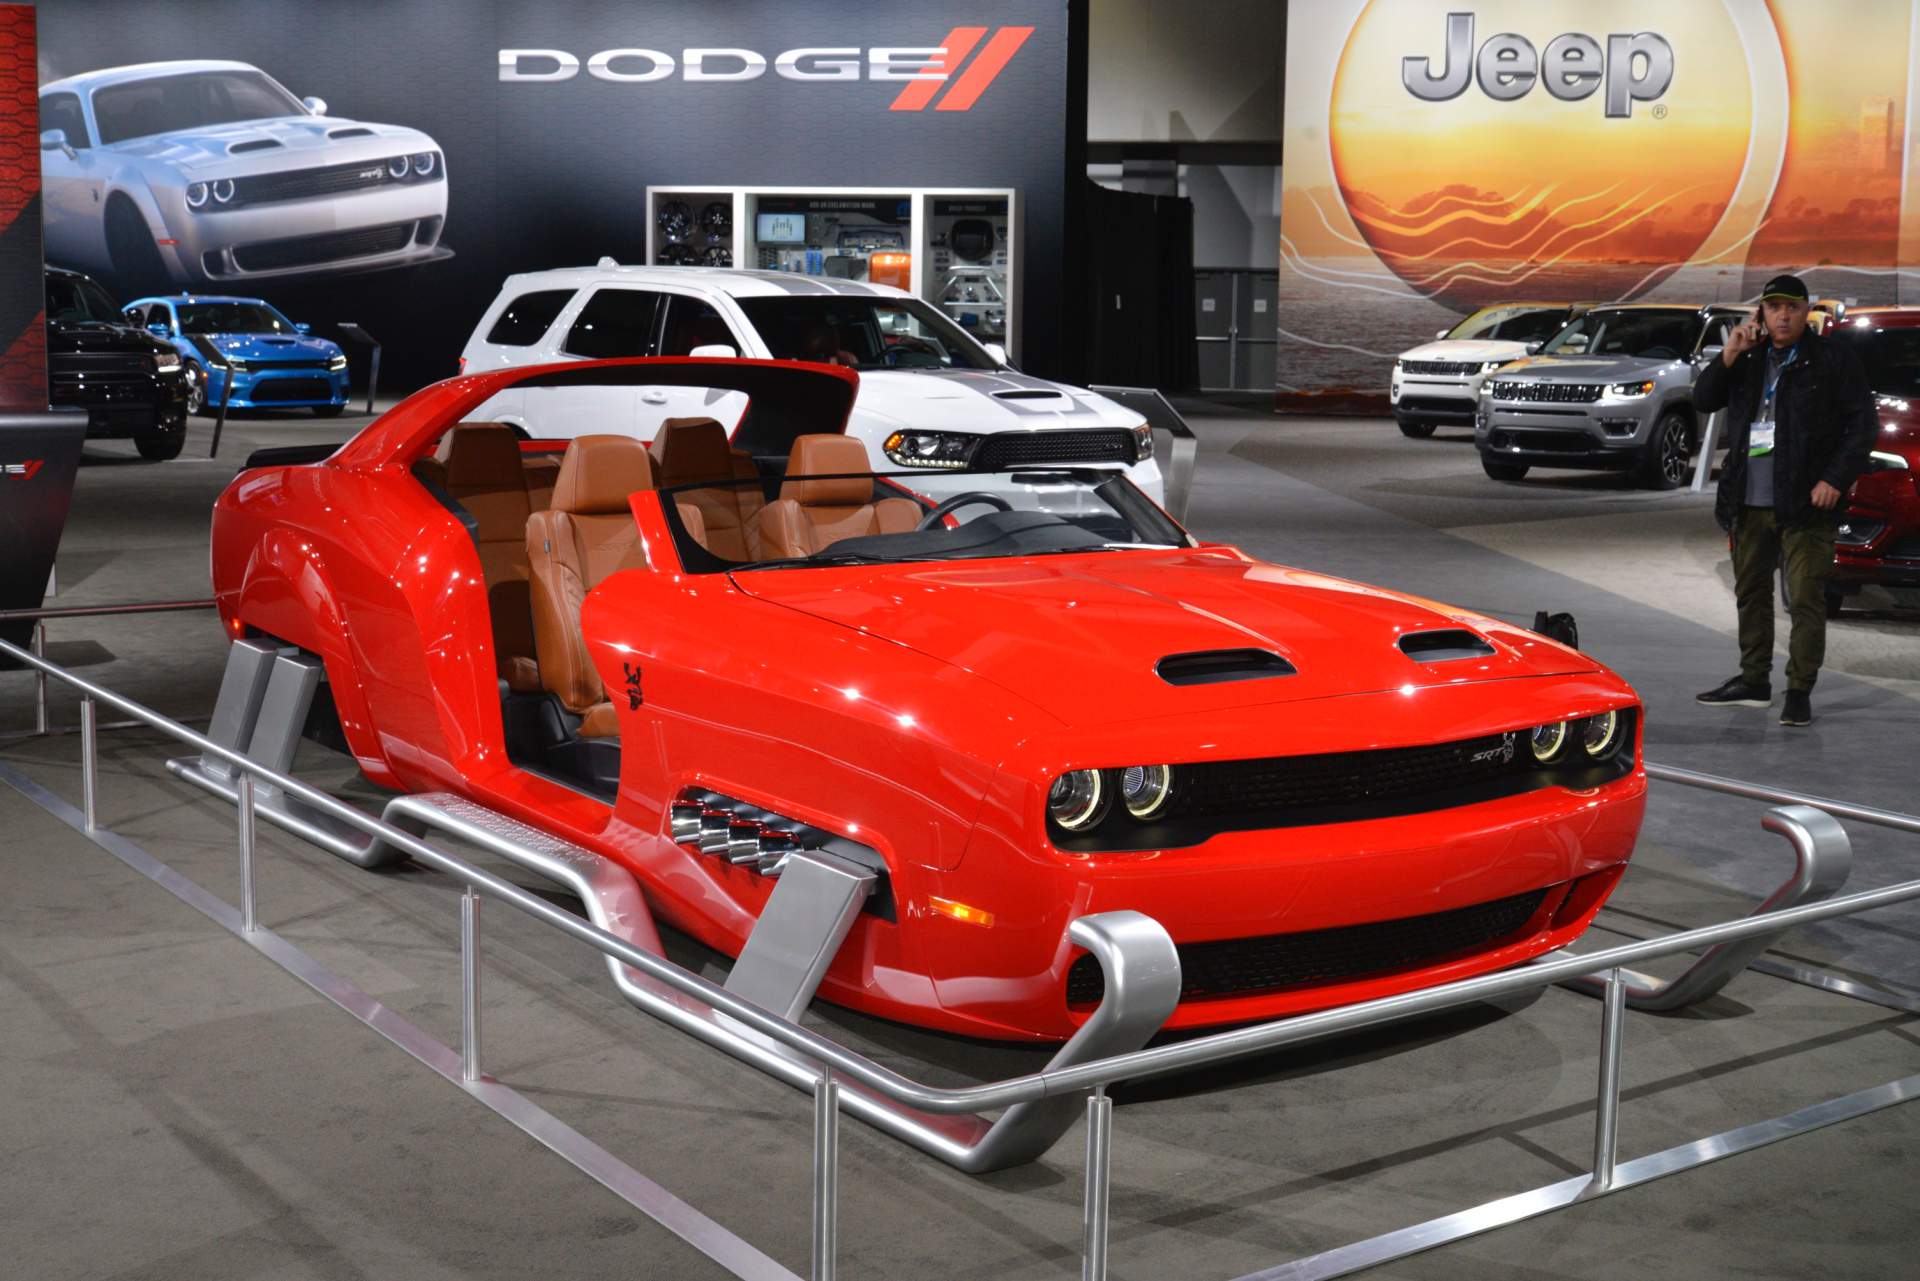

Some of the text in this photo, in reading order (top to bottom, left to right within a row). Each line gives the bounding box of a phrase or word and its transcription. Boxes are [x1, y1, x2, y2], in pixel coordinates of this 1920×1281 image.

[498, 47, 949, 82] DODGE
[1402, 12, 1675, 118] Jeep
[1470, 746, 1505, 763] SRT
